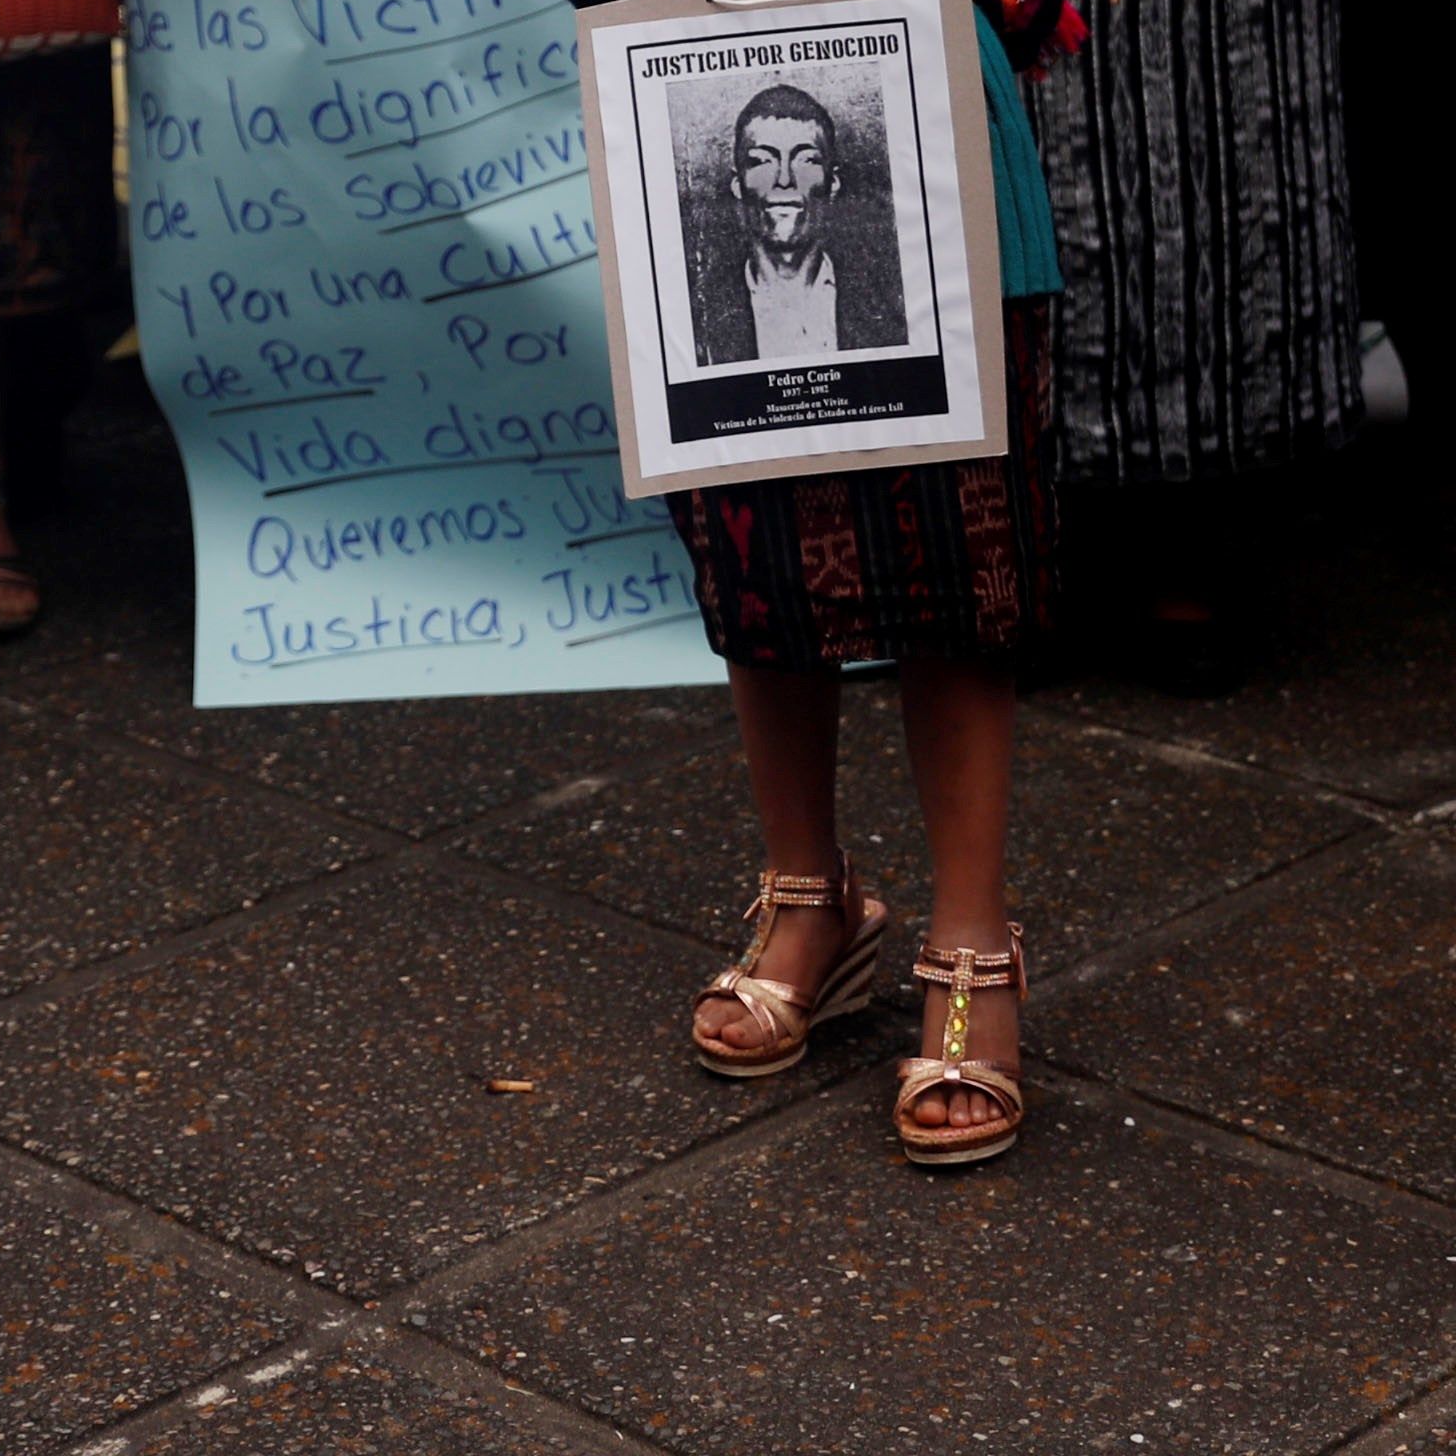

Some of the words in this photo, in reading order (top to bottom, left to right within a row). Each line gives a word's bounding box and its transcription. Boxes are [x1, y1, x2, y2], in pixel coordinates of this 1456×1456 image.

[642, 48, 740, 79] JUSTICIA
[744, 44, 785, 68] POR
[790, 33, 900, 63] GENOCIDIO
[140, 91, 203, 163] Por
[227, 76, 289, 153] la
[143, 191, 197, 245] de
[214, 177, 308, 235] los
[209, 269, 291, 325] Por
[182, 363, 251, 404] de
[447, 312, 568, 371] Por
[767, 372, 804, 388] Pedro
[807, 368, 842, 384] Corio
[746, 417, 757, 426] de
[758, 416, 767, 425] la
[768, 412, 805, 424] violencia
[806, 410, 817, 420] de
[818, 408, 846, 419] Estado
[858, 405, 867, 415] el
[868, 404, 887, 414] área
[888, 402, 904, 412] Ixil
[766, 401, 810, 414] Masacrado
[811, 400, 822, 409] en
[218, 417, 391, 484] Vida
[246, 496, 527, 587] Queremos
